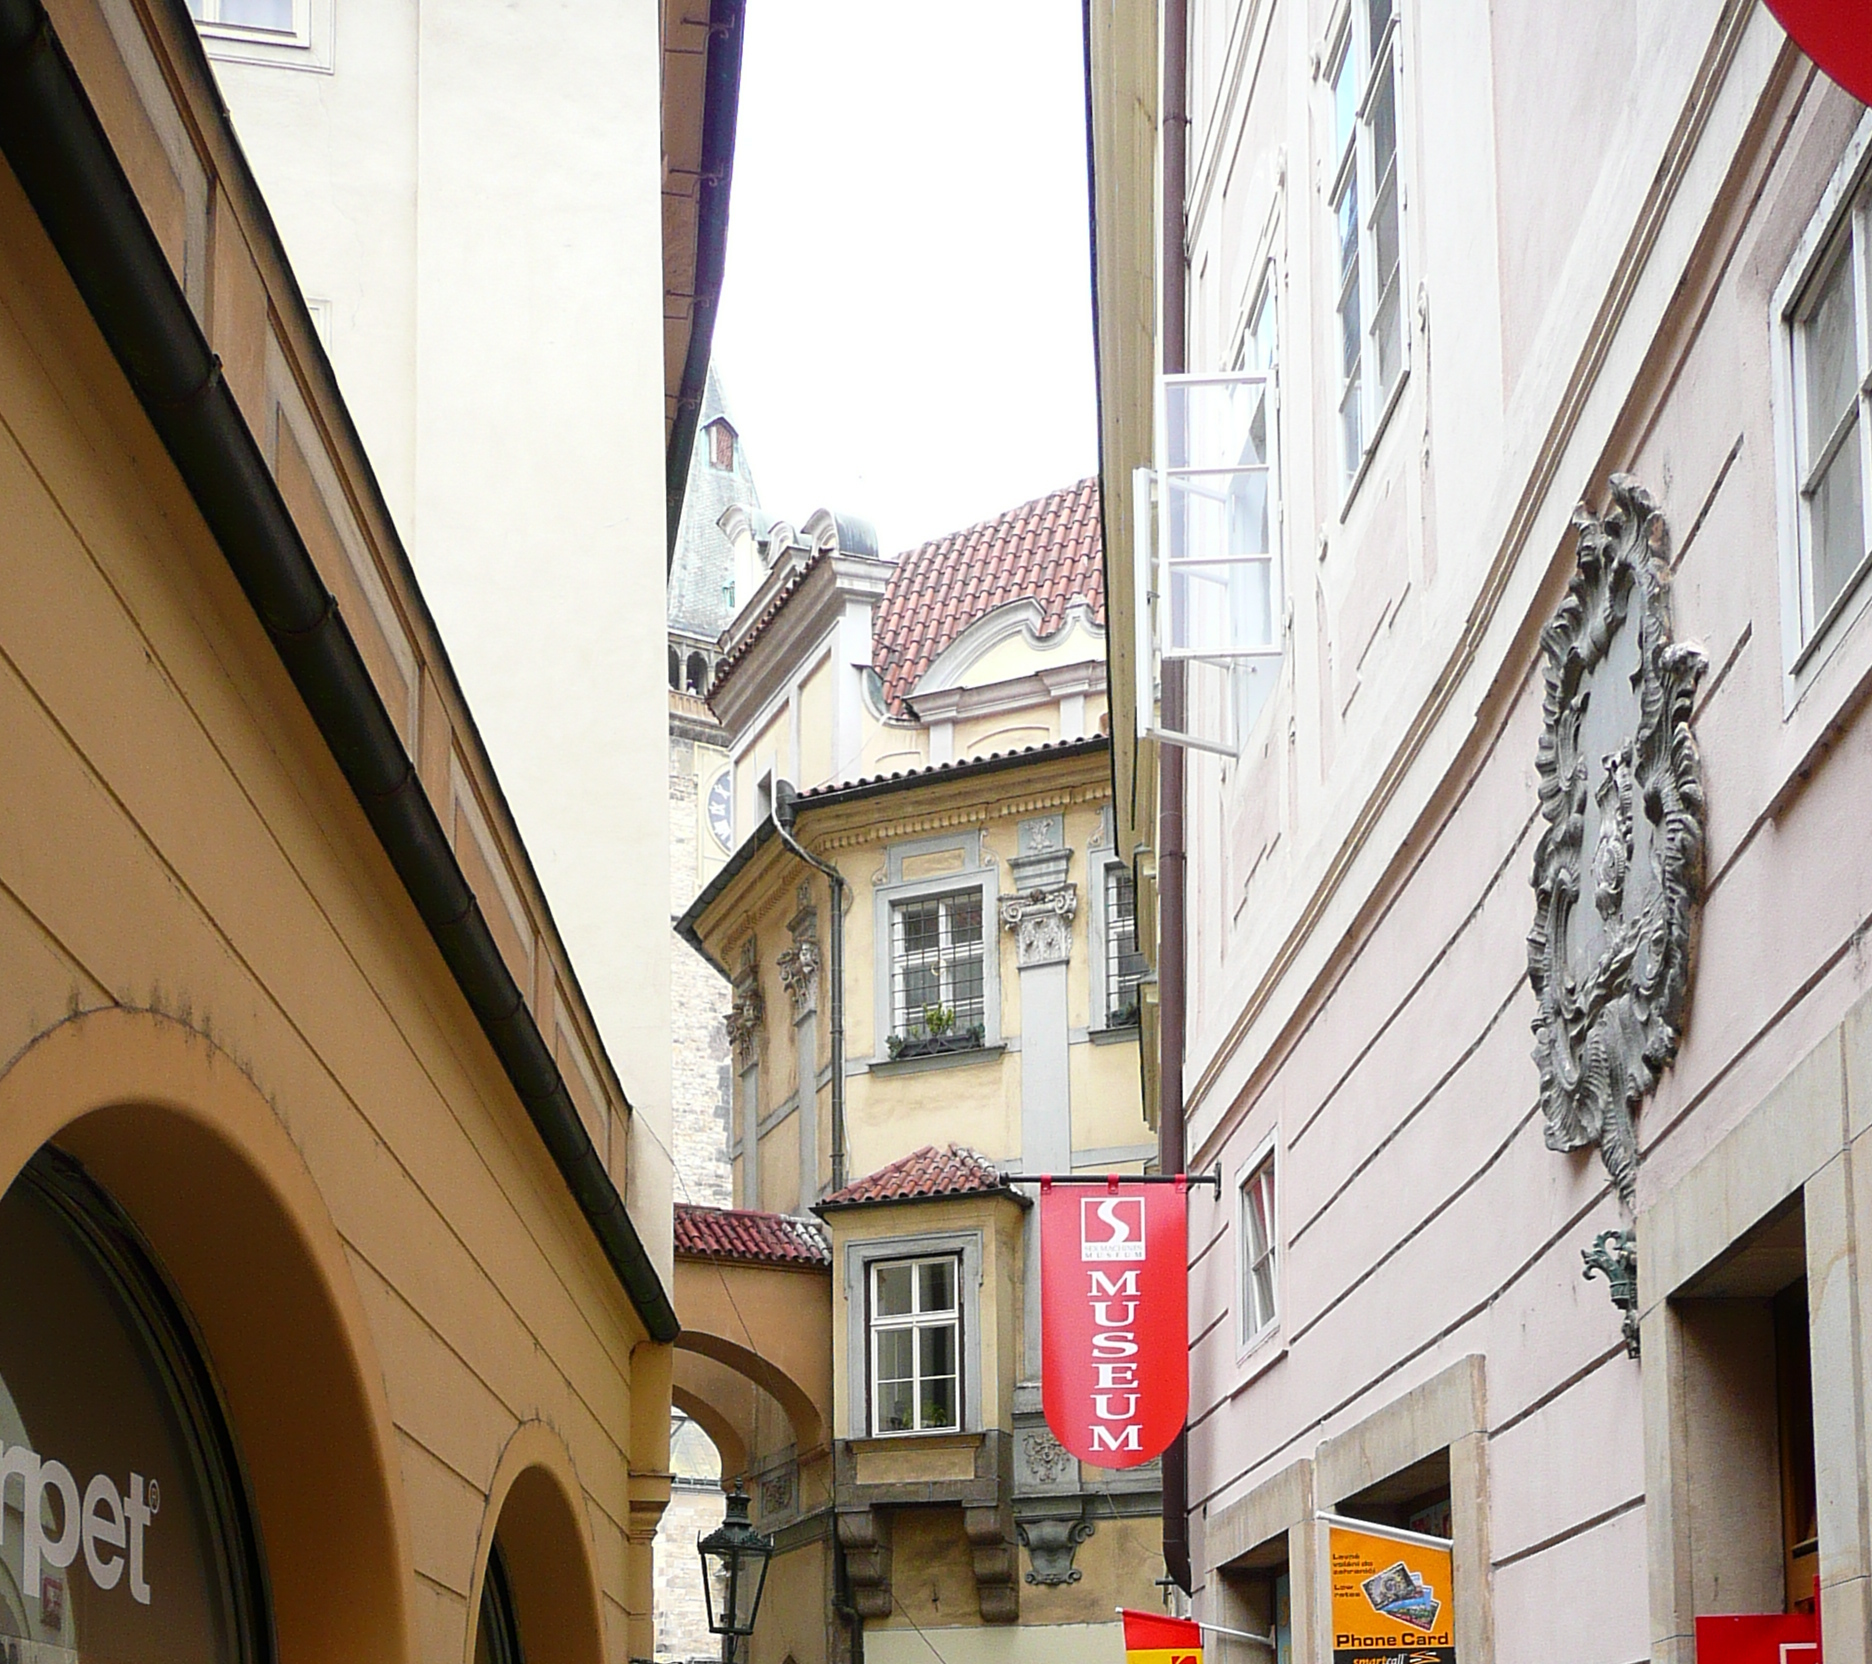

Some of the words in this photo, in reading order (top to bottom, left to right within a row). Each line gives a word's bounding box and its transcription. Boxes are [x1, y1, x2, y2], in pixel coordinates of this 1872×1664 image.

[1086, 1270, 1144, 1452] MUSEUM
[1336, 1633, 1397, 1648] Phone
[1401, 1631, 1449, 1646] Card
